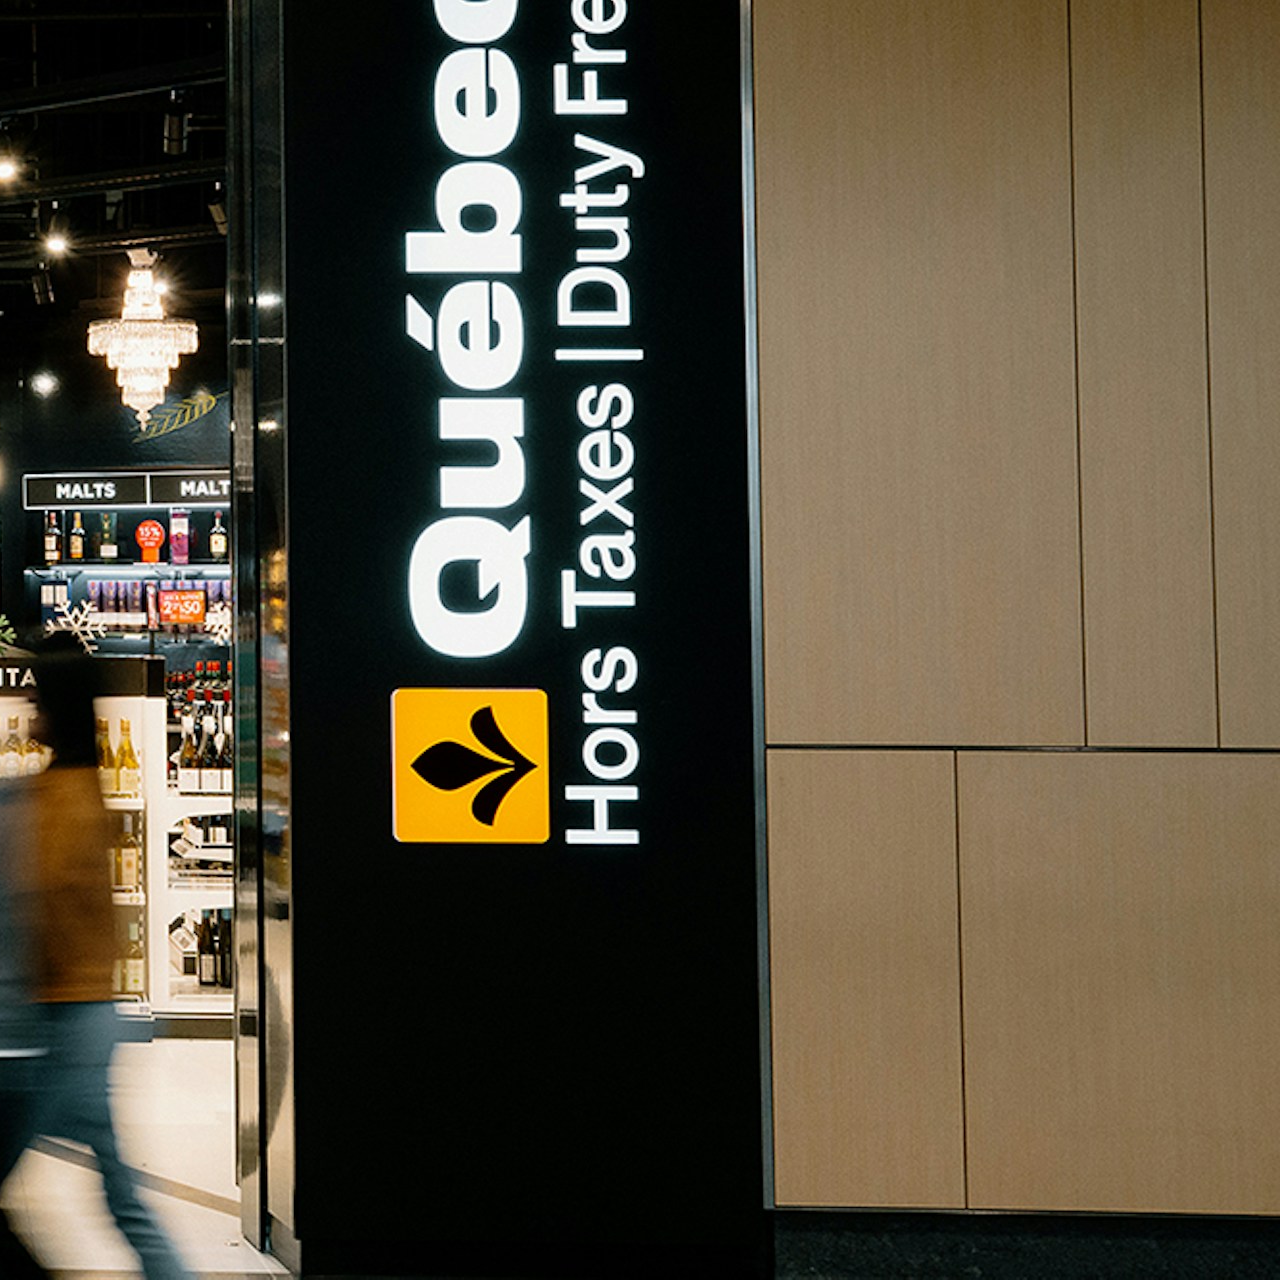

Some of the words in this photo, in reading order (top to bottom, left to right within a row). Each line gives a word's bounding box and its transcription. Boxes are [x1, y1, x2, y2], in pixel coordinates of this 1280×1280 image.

[556, 133, 644, 327] Duty
[56, 483, 116, 499] MALTS
[181, 481, 231, 496] MALT
[561, 384, 637, 628] Taxes
[565, 647, 640, 845] Hors
